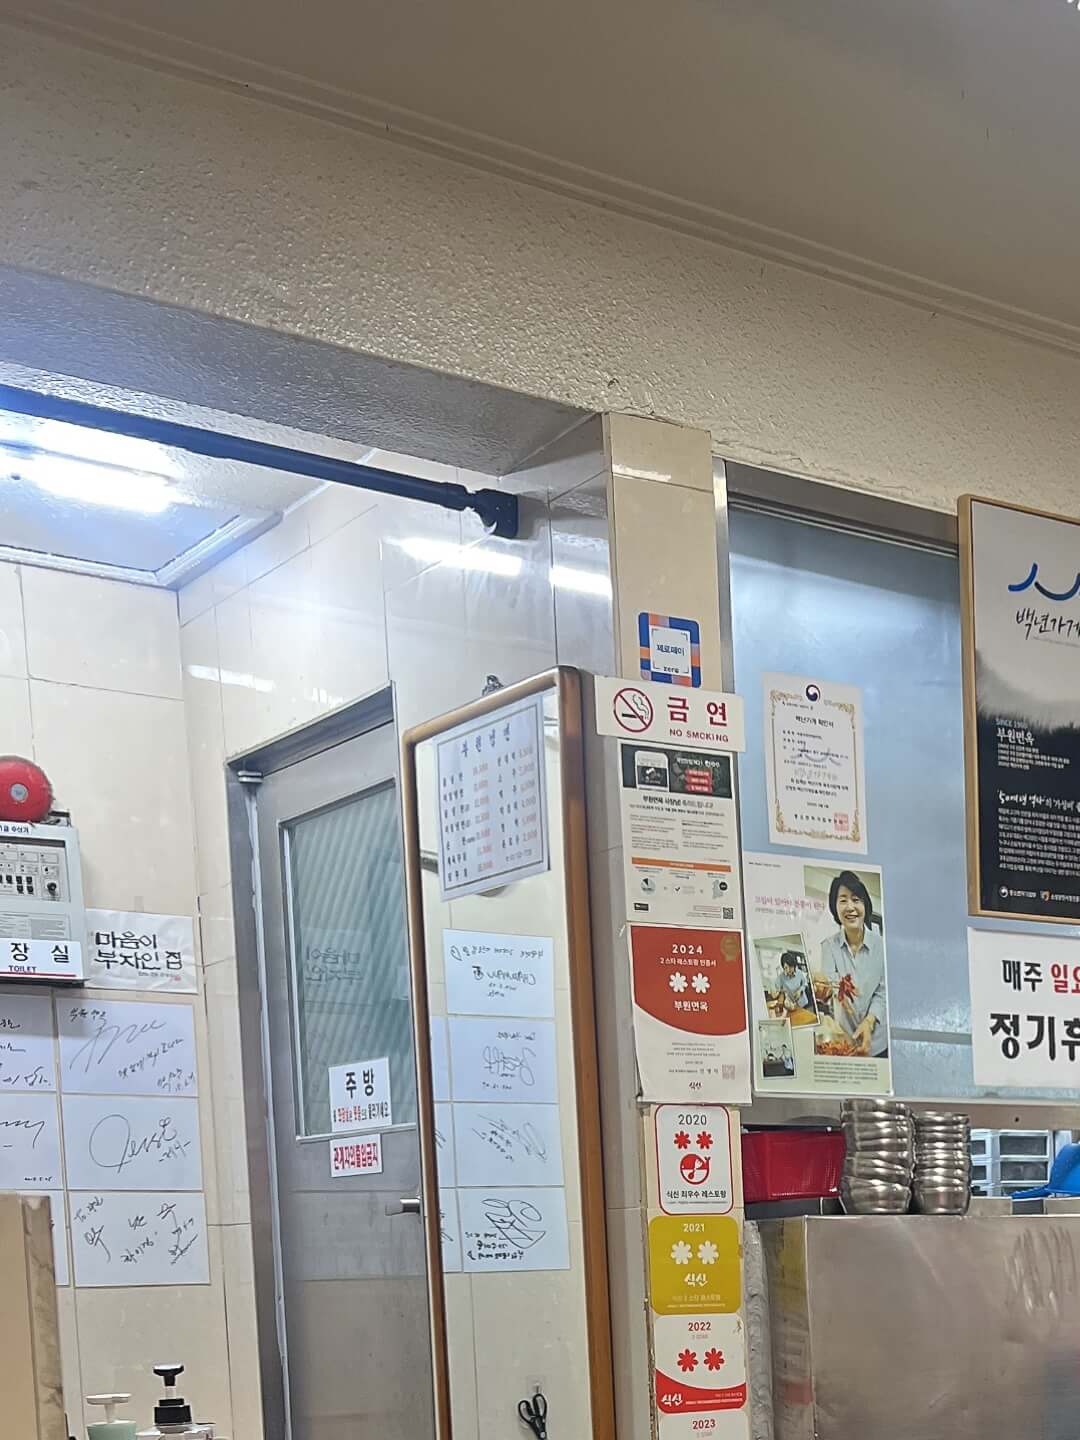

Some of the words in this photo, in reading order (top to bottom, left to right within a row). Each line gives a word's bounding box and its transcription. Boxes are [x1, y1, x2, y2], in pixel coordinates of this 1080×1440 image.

[669, 728, 683, 737] NO
[687, 730, 729, 742] SMOKING
[996, 727, 1035, 746] 부원면옥
[95, 930, 158, 949] 마음이
[672, 943, 703, 955] 2024
[94, 949, 161, 971] 부자인
[8, 965, 37, 974] TOILET
[1002, 959, 1043, 993] 매주
[674, 1000, 709, 1012] 부원면옥
[345, 1067, 375, 1099] 주방
[678, 1114, 707, 1126] 2020
[667, 1190, 680, 1199] 식신
[681, 1190, 700, 1199] 최우수
[701, 1190, 727, 1199] 레스토랑
[683, 1223, 705, 1233] 2021
[684, 1273, 708, 1288] 식신
[688, 1322, 711, 1332] 2022
[661, 1393, 683, 1407] 식신
[692, 1419, 716, 1430] 2023
